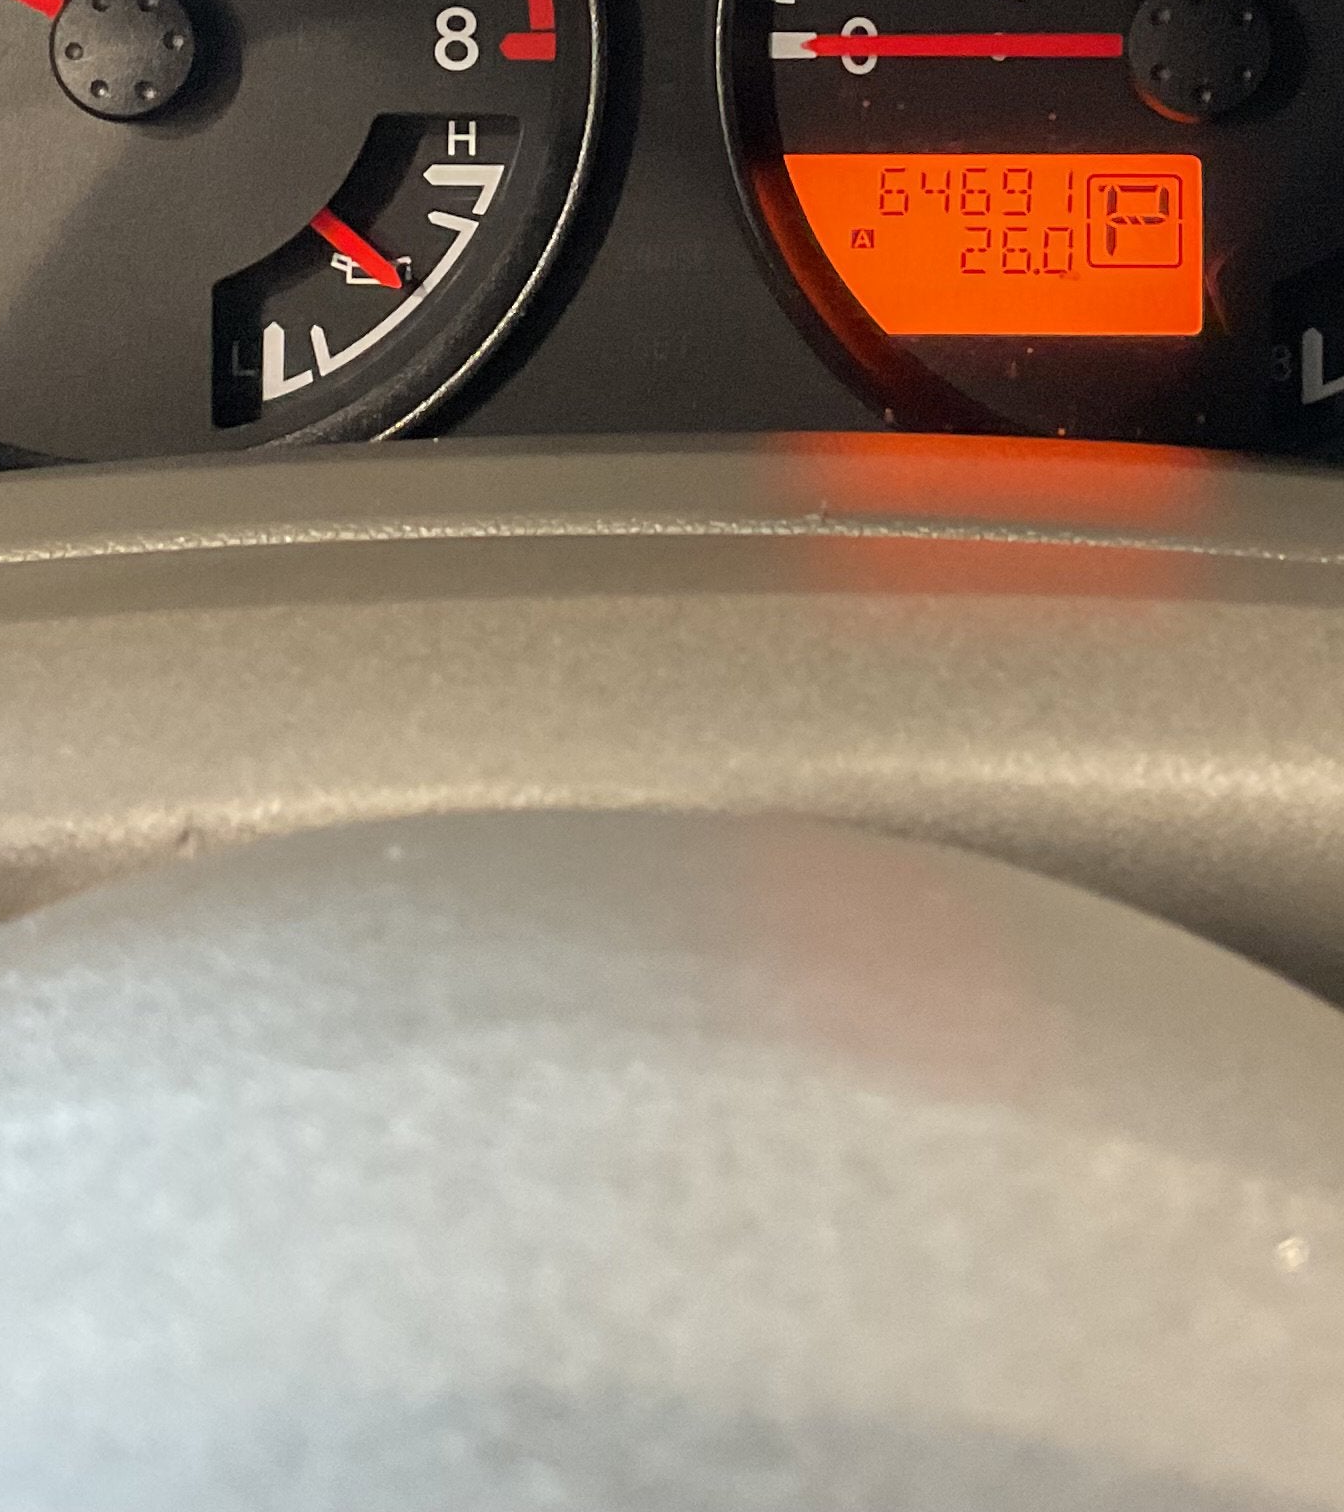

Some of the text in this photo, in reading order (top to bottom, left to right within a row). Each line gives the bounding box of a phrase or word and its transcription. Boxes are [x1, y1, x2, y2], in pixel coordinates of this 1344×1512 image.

[434, 8, 479, 71] 8
[447, 121, 476, 156] H
[879, 168, 1074, 216] 64691
[1099, 184, 1170, 256] P
[960, 227, 1074, 275] 26.0
